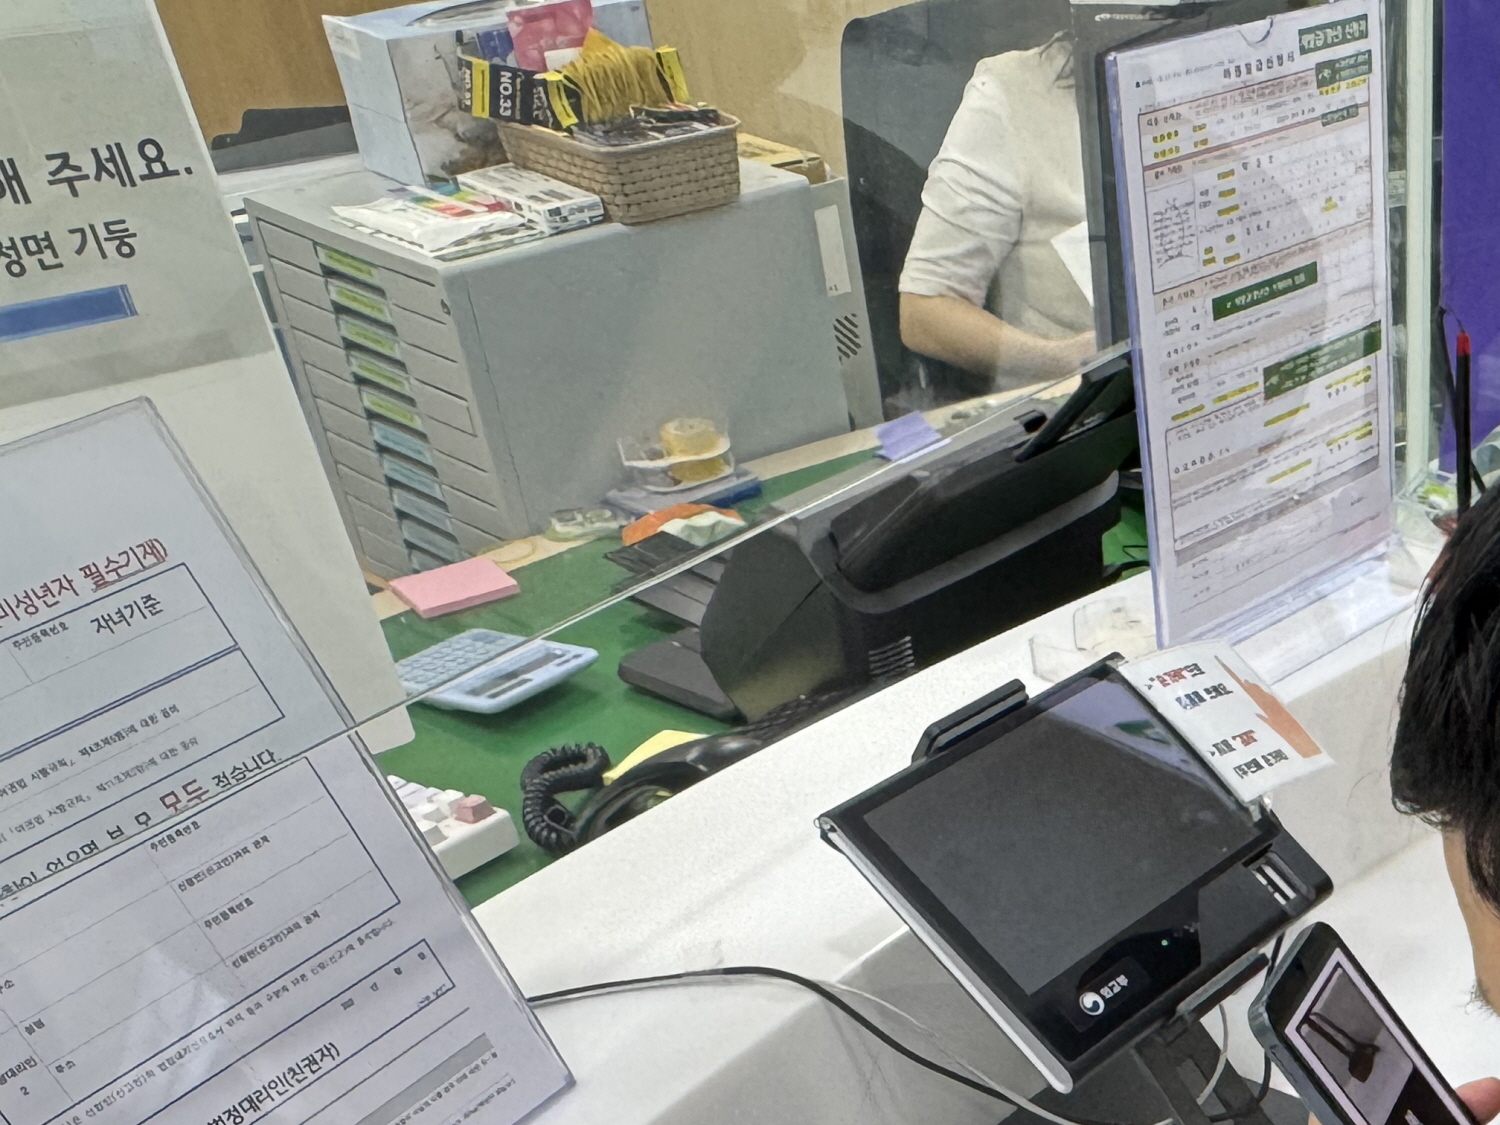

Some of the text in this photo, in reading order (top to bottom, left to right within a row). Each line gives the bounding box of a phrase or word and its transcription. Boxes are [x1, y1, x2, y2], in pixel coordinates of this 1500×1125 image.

[46, 152, 90, 197] 주
[91, 138, 193, 188] 세요.
[68, 219, 138, 259] 기둥
[79, 538, 168, 591] 필수기재)
[91, 595, 163, 633] 자녀기준
[160, 779, 210, 815] 모두
